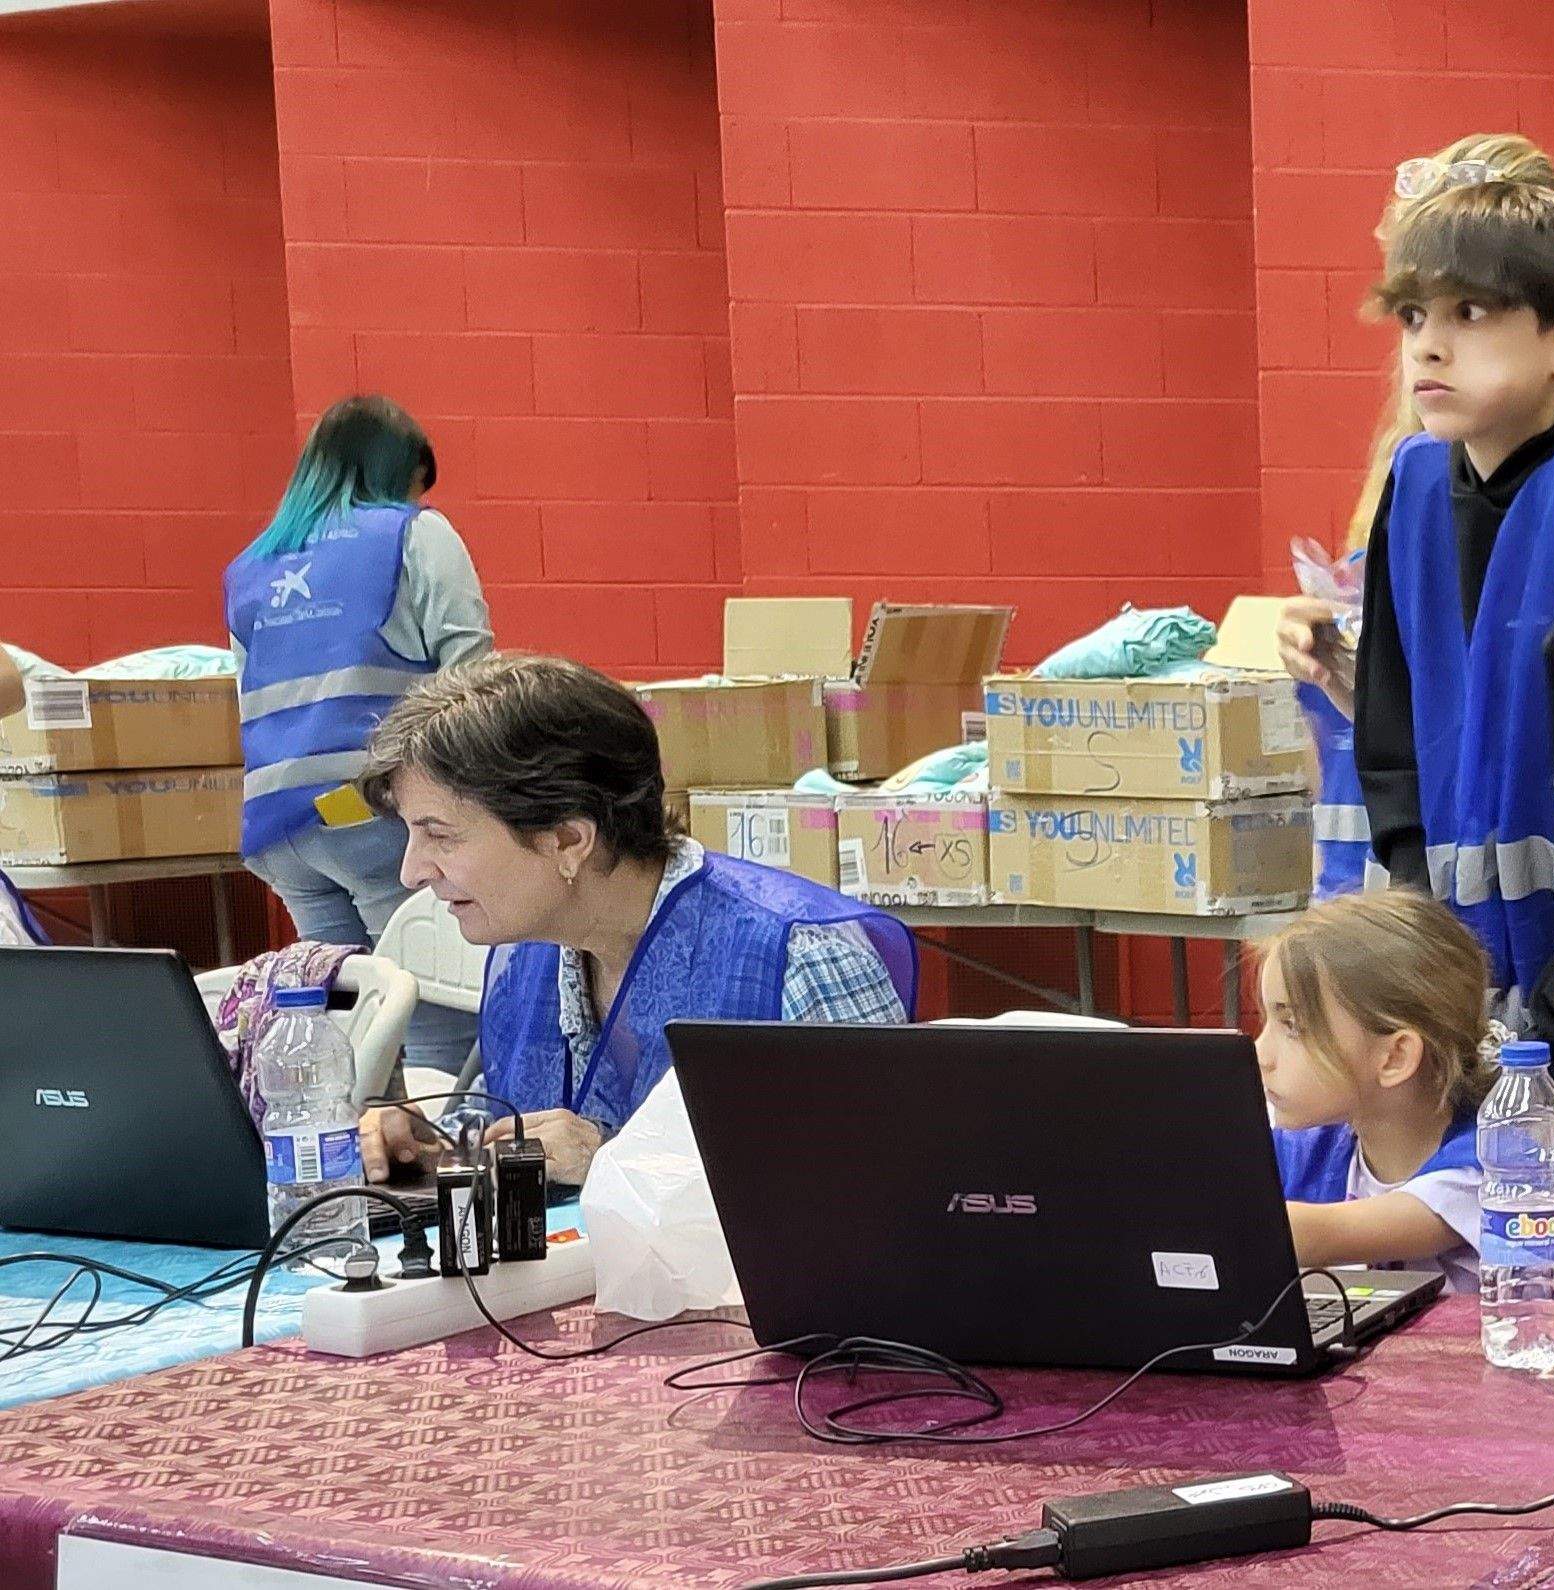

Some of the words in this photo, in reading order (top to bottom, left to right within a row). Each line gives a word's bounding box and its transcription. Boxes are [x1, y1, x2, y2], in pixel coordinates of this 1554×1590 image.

[1020, 696, 1207, 731] YOUUNLIMITED
[731, 812, 764, 860] 16
[872, 815, 909, 874] 16
[940, 839, 973, 867] XS
[36, 1089, 90, 1108] ASUS
[946, 1192, 1038, 1215] ASUS
[457, 1205, 472, 1254] AGON
[1228, 1348, 1279, 1360] ARAGON
